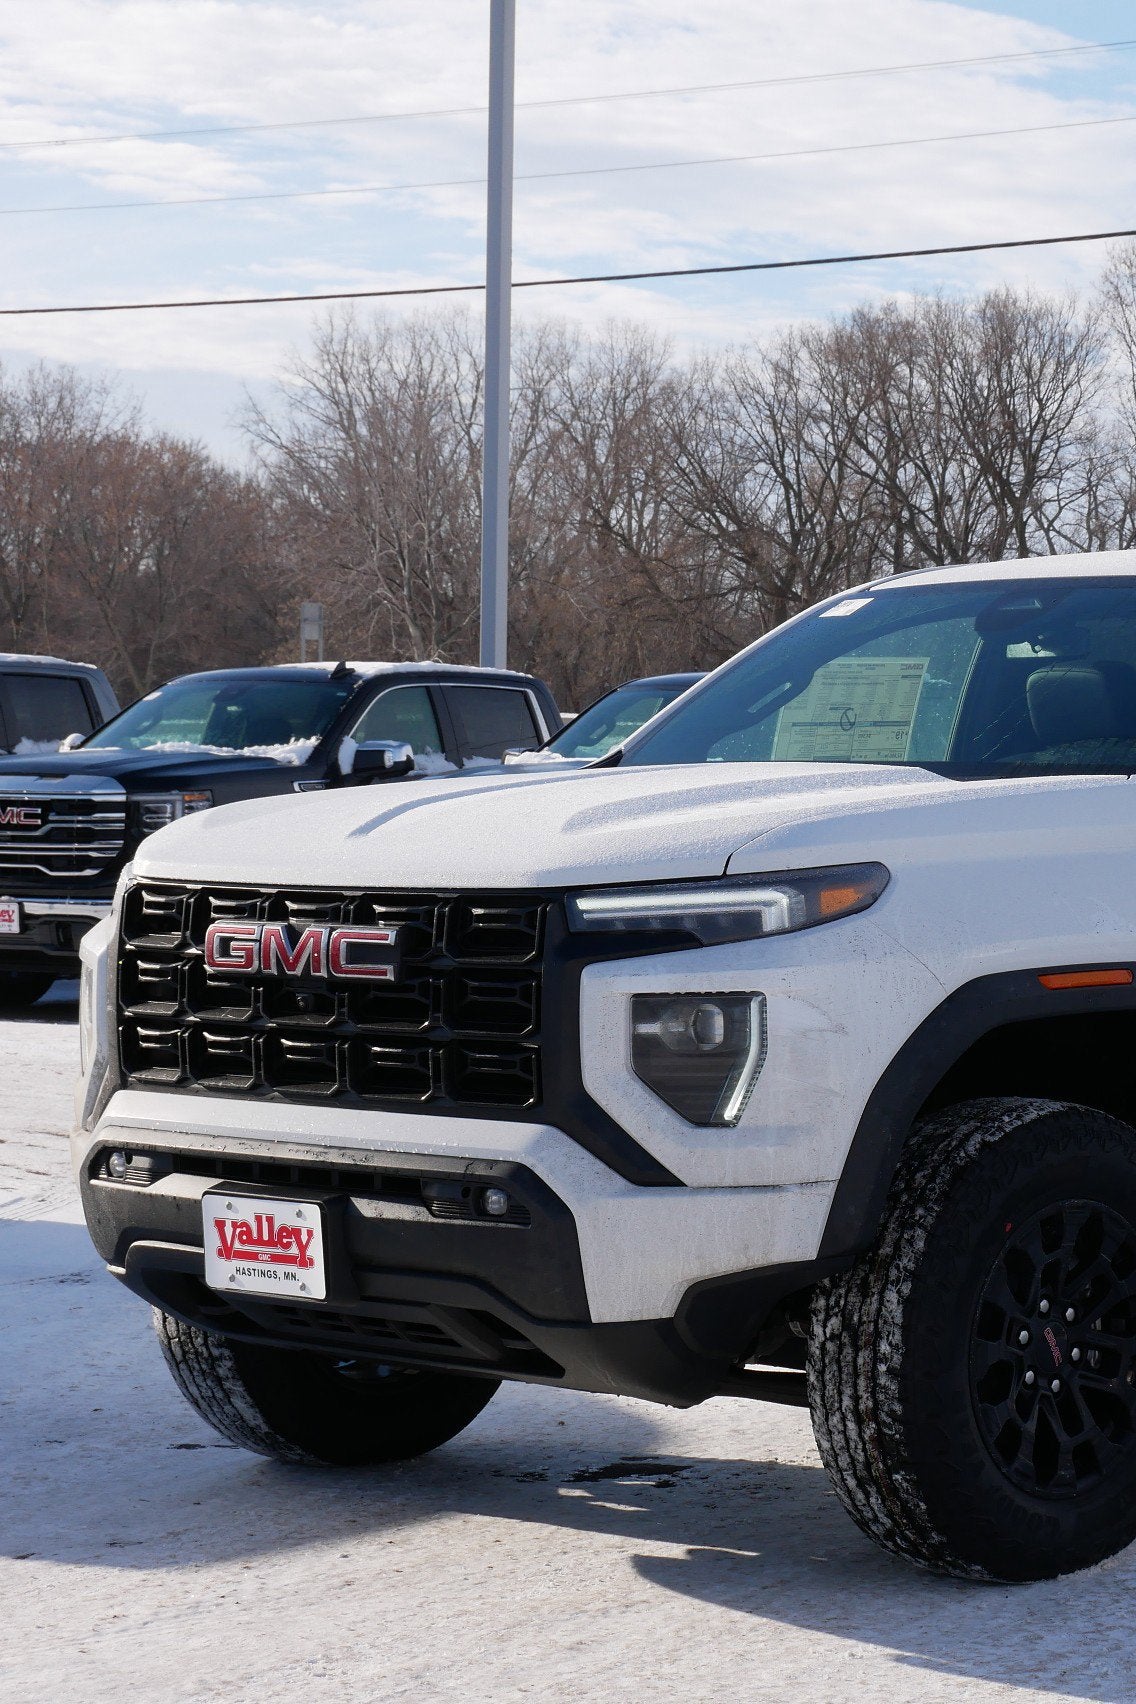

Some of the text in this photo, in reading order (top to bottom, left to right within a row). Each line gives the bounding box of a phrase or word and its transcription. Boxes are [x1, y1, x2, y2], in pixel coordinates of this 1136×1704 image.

[0, 806, 42, 825] MC
[205, 923, 397, 981] GMC
[214, 1213, 314, 1269] Valley
[258, 1253, 271, 1261] GMC
[235, 1266, 300, 1282] HASTINGS, MN.
[1044, 1327, 1062, 1366] GMC
